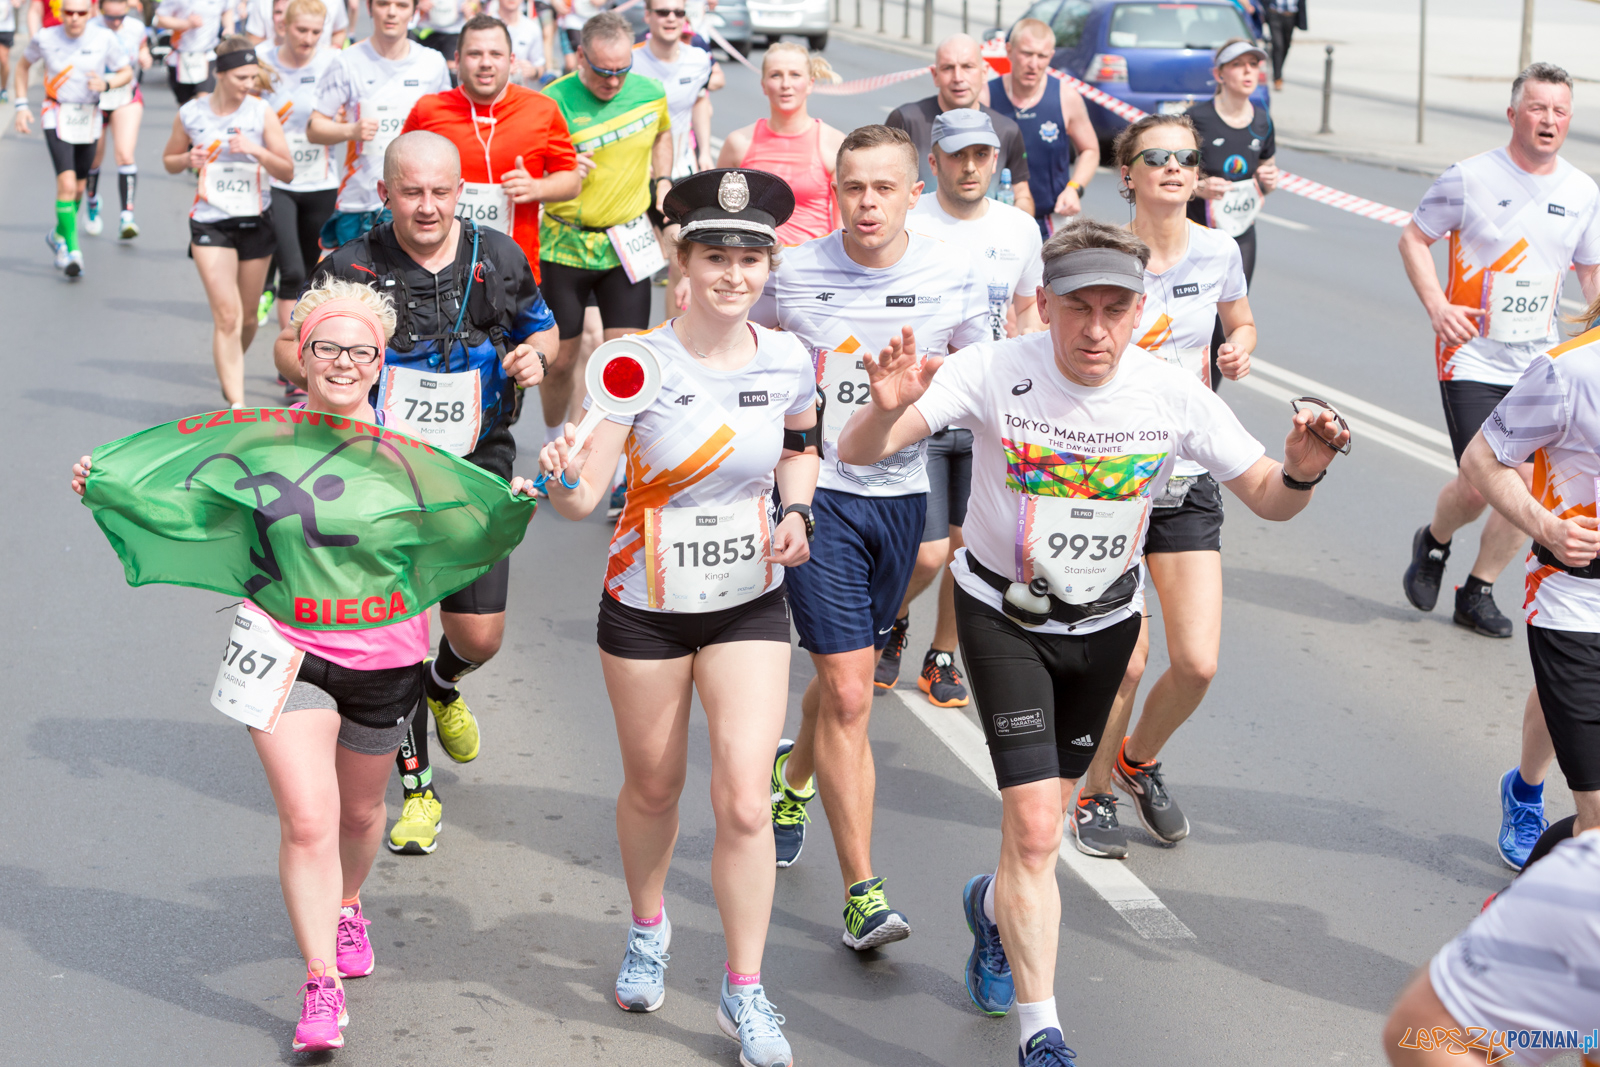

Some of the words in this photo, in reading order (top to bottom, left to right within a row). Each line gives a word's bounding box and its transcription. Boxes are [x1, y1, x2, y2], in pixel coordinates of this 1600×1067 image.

[216, 180, 251, 193] 8421
[457, 202, 498, 220] 7168
[1223, 198, 1255, 214] 6461
[815, 292, 835, 301] 4F
[1501, 295, 1549, 313] 2867
[674, 395, 695, 405] 4F
[837, 381, 870, 405] 82
[404, 398, 464, 423] 7258
[1005, 414, 1050, 433] TOKYO
[1054, 427, 1134, 444] MARATHON
[1139, 430, 1169, 441] 2018
[1048, 439, 1064, 448] THE
[673, 534, 756, 567] 11853
[1048, 533, 1127, 561] 9938
[705, 571, 730, 581] Kinga
[1064, 566, 1106, 574] Stanisław
[294, 592, 408, 625] BIEGA
[223, 671, 246, 688] KARINA
[1010, 715, 1035, 723] LONDON
[1011, 718, 1042, 726] MARATHON
